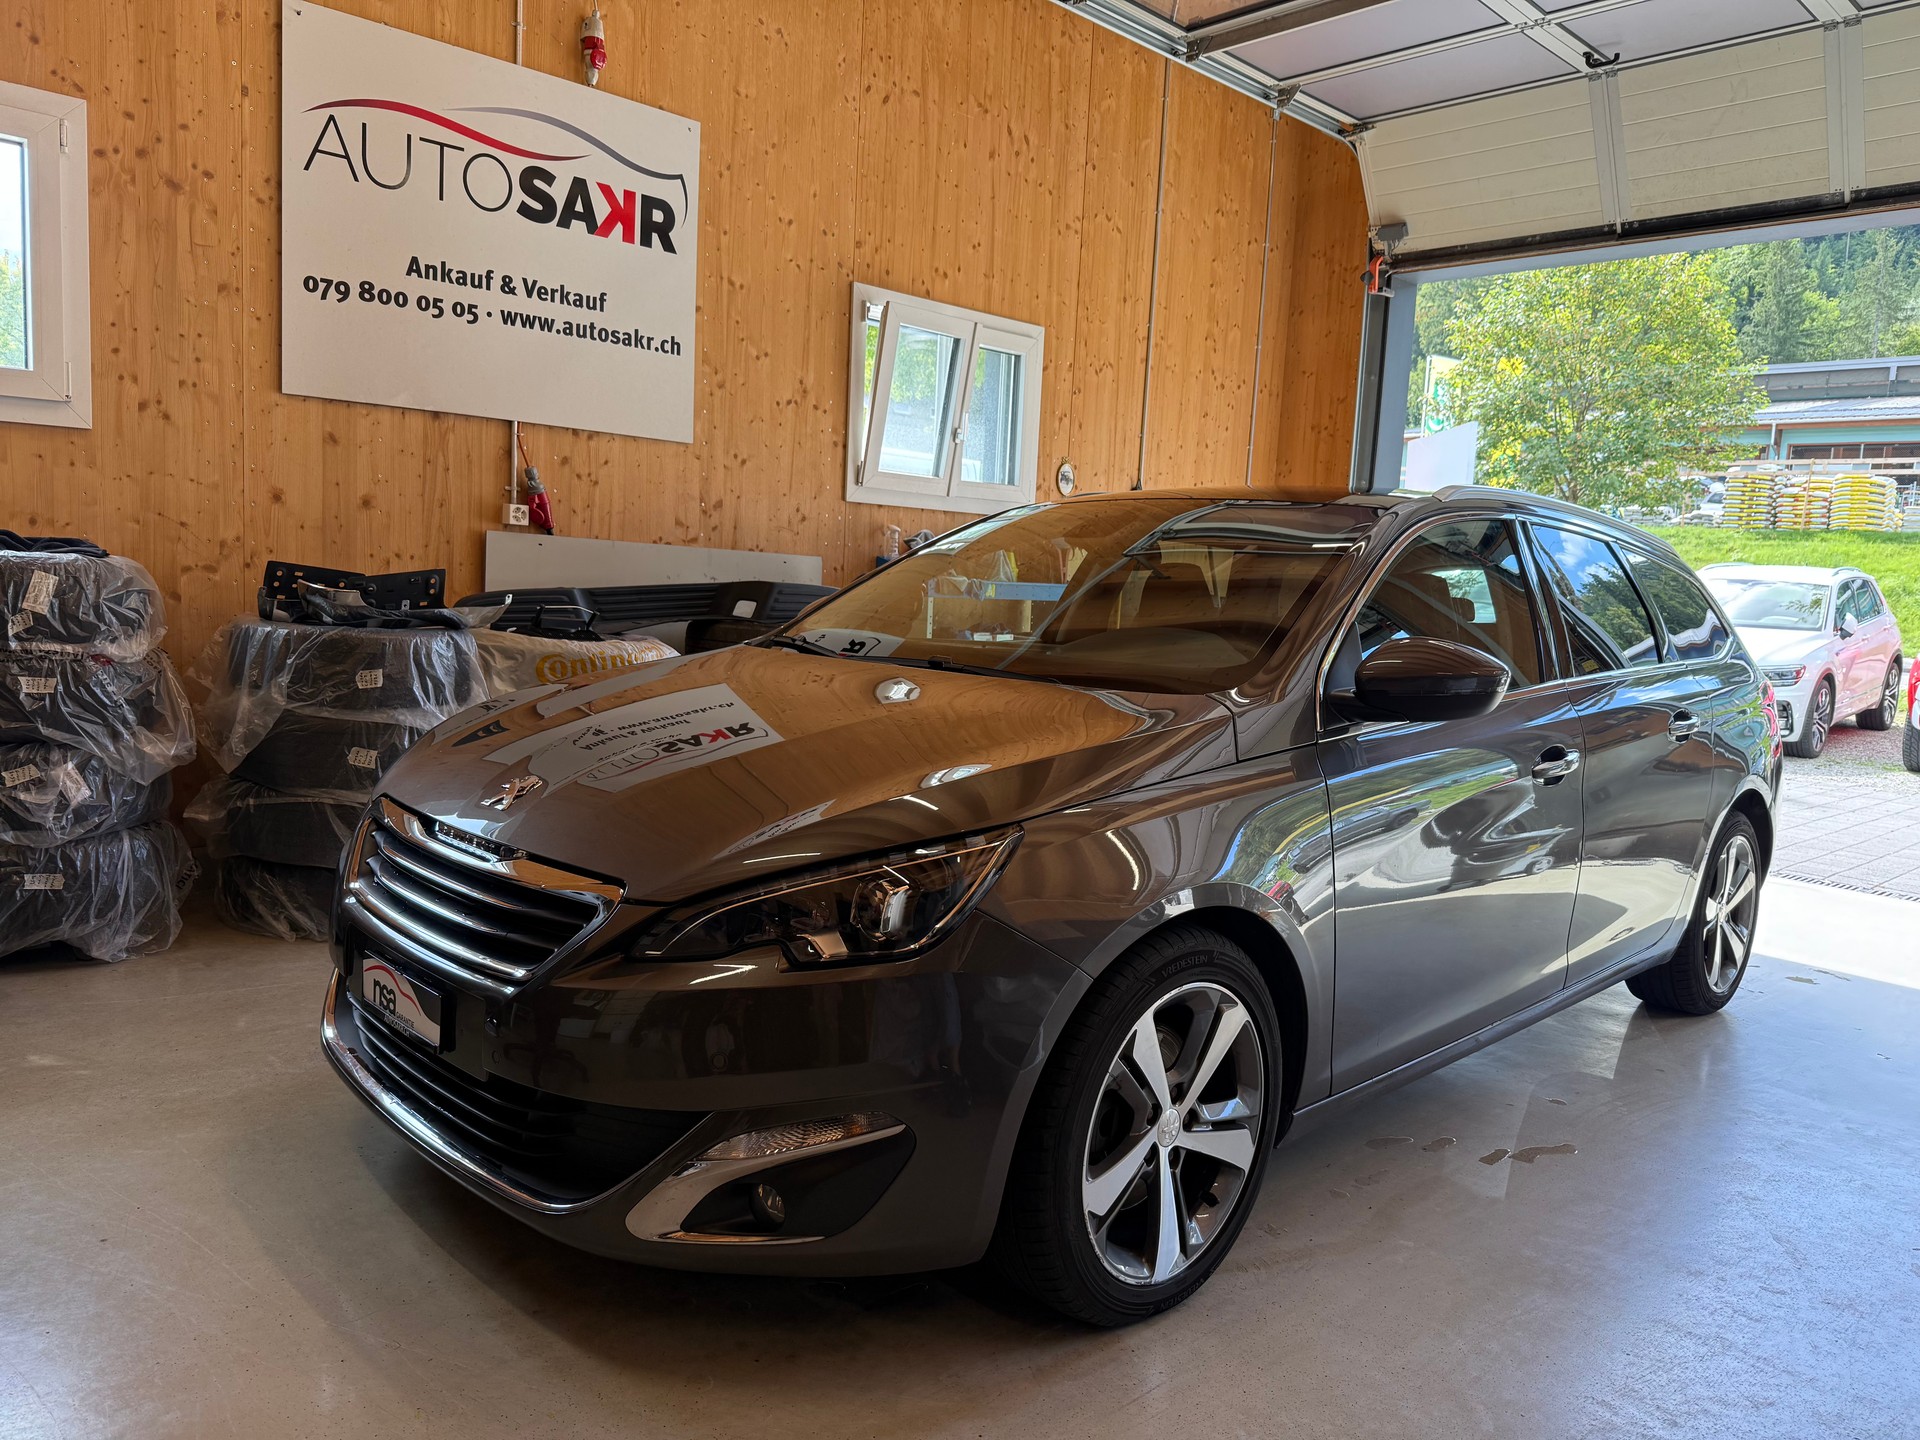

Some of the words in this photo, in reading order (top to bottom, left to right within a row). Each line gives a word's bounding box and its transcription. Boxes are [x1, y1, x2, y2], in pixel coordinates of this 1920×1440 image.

[303, 114, 677, 254] AUTOSAKR
[405, 256, 494, 291] Ankauf
[500, 275, 517, 296] &
[521, 277, 607, 312] Verkauf
[303, 276, 350, 303] 079
[359, 281, 408, 308] 800
[416, 295, 444, 319] 05
[451, 302, 479, 324] 05
[500, 310, 681, 356] www.autosakr.ch
[1161, 955, 1208, 978] VREDESTEIN
[373, 978, 396, 1016] nsa
